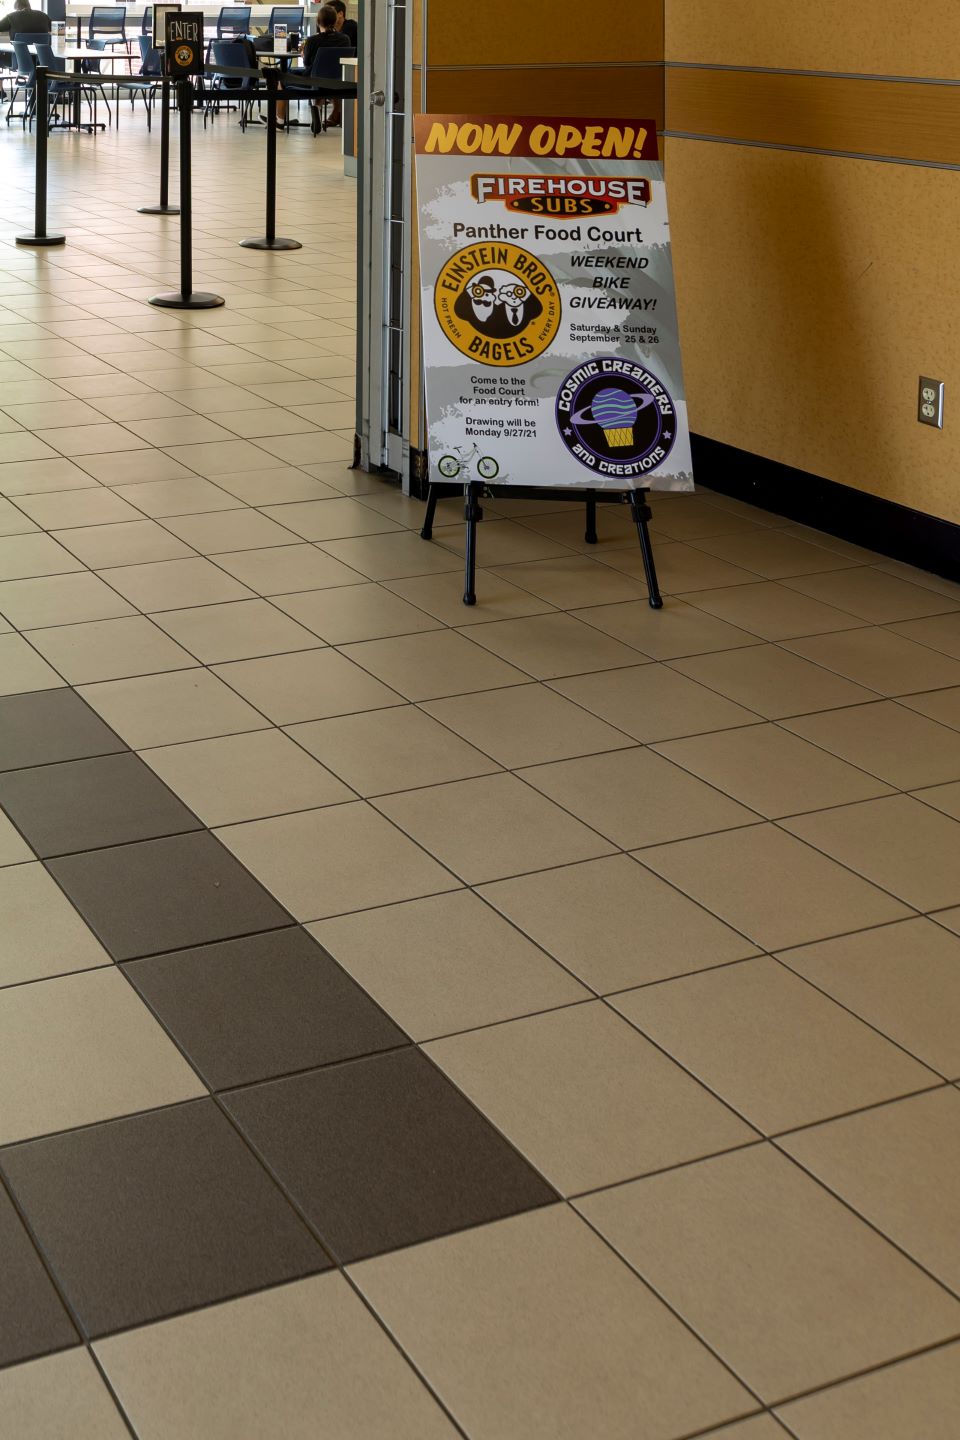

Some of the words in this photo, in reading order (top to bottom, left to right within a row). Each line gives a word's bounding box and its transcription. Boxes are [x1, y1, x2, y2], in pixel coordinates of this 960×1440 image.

[170, 20, 199, 42] ENTER
[424, 122, 523, 154] NOW
[529, 124, 648, 159] OPEN!
[477, 178, 647, 208] FIREHOUSE
[531, 197, 593, 214] SUBS
[453, 222, 529, 239] Panther
[534, 224, 582, 241] Food
[587, 226, 643, 243] Court
[570, 255, 649, 269] WEEKEND
[441, 247, 508, 292] EINSTEIN
[513, 253, 553, 296] BROS
[592, 276, 631, 289] BIKE
[569, 296, 657, 311] GIVEAWAY!
[444, 316, 462, 339] FRESH
[538, 322, 552, 342] EVERY
[570, 323, 611, 333] Saturday
[613, 324, 621, 332] &
[622, 324, 657, 335] Sunday
[569, 333, 620, 343] September
[625, 335, 636, 343] 25
[638, 335, 646, 343] &
[647, 335, 659, 344] 26
[468, 336, 534, 361] BAGELS
[470, 375, 498, 385] Come
[500, 377, 509, 385] to
[511, 377, 526, 386] the
[558, 362, 599, 412] COSMIC
[473, 387, 496, 395] Food
[498, 387, 525, 396] Court
[459, 396, 472, 404] for
[488, 398, 513, 407] entry
[515, 398, 539, 407] form!
[465, 417, 504, 428] Drawing
[506, 418, 522, 427] will
[524, 419, 536, 427] be
[465, 428, 501, 438] Monday
[504, 429, 537, 438] 9/27/21
